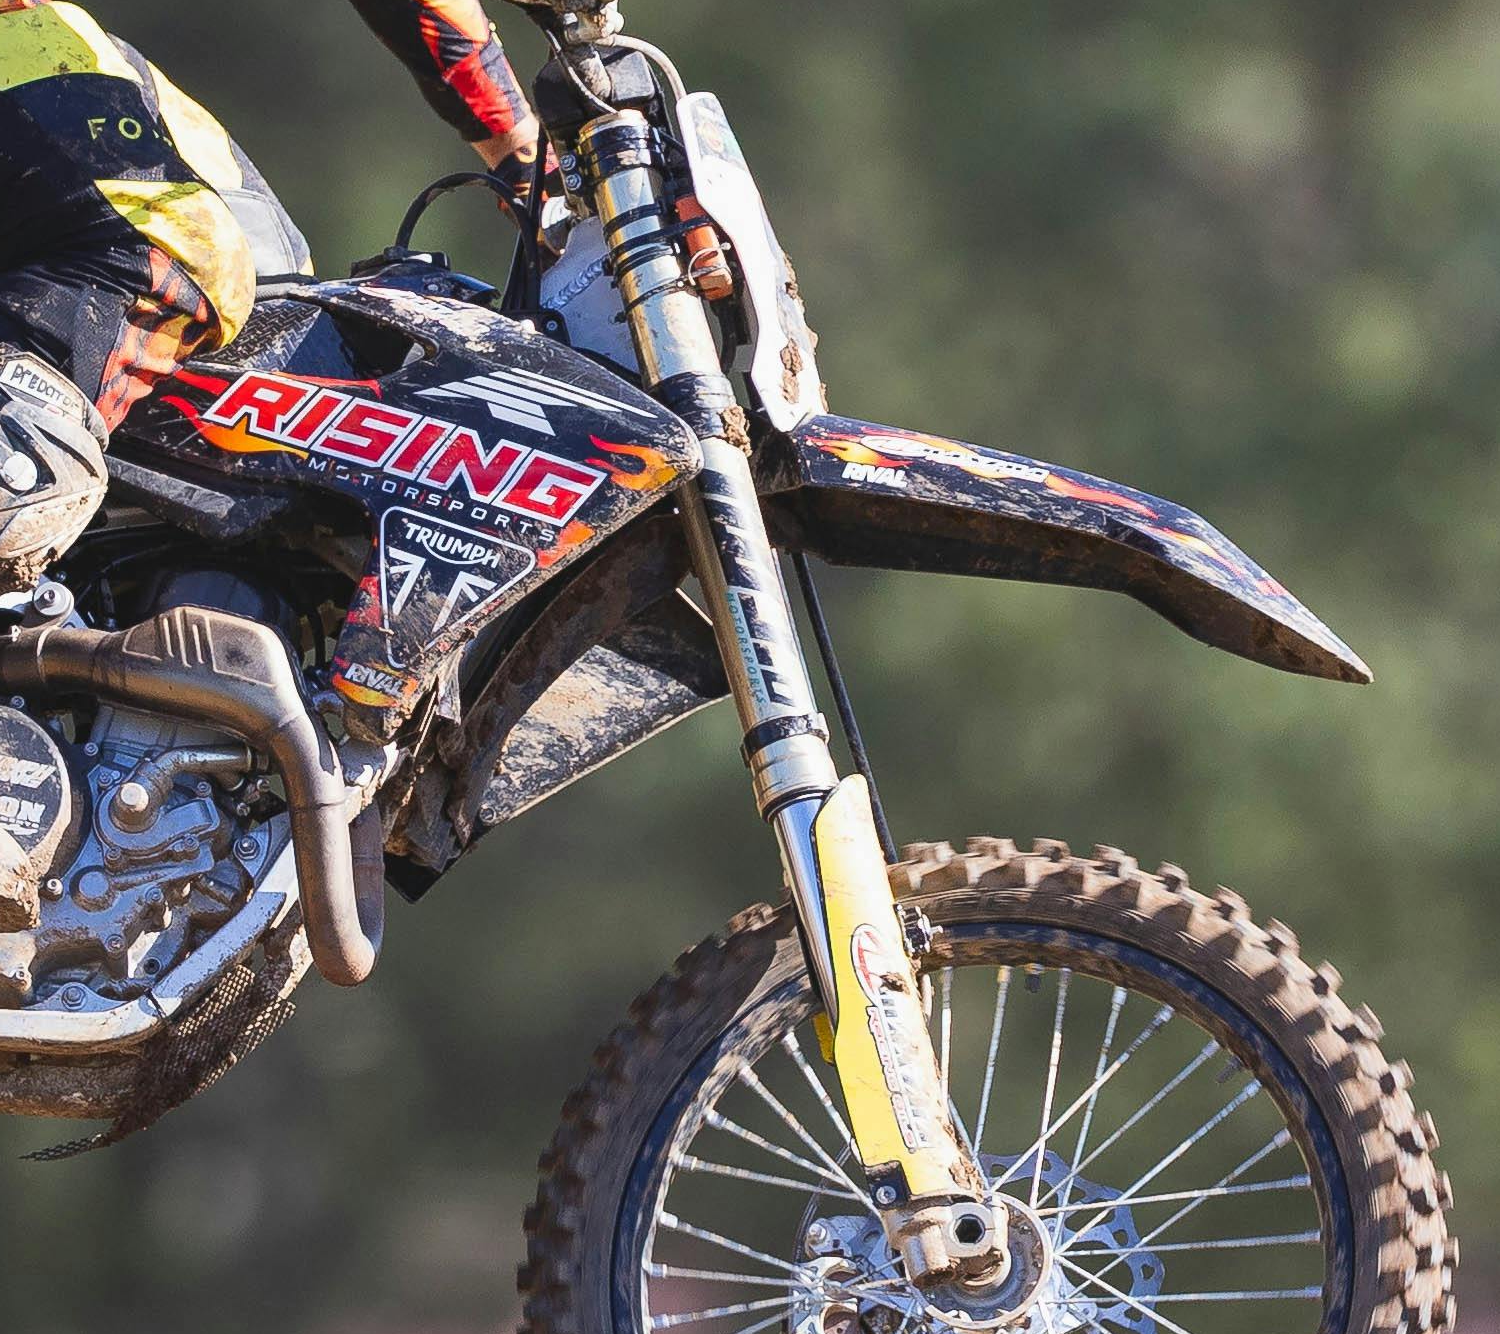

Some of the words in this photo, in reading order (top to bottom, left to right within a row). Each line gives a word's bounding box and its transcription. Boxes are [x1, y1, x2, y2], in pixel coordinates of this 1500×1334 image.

[202, 371, 608, 527] RISING
[841, 461, 908, 488] RIVAL
[405, 523, 502, 569] TRIUMPH
[344, 662, 404, 699] RIVAL
